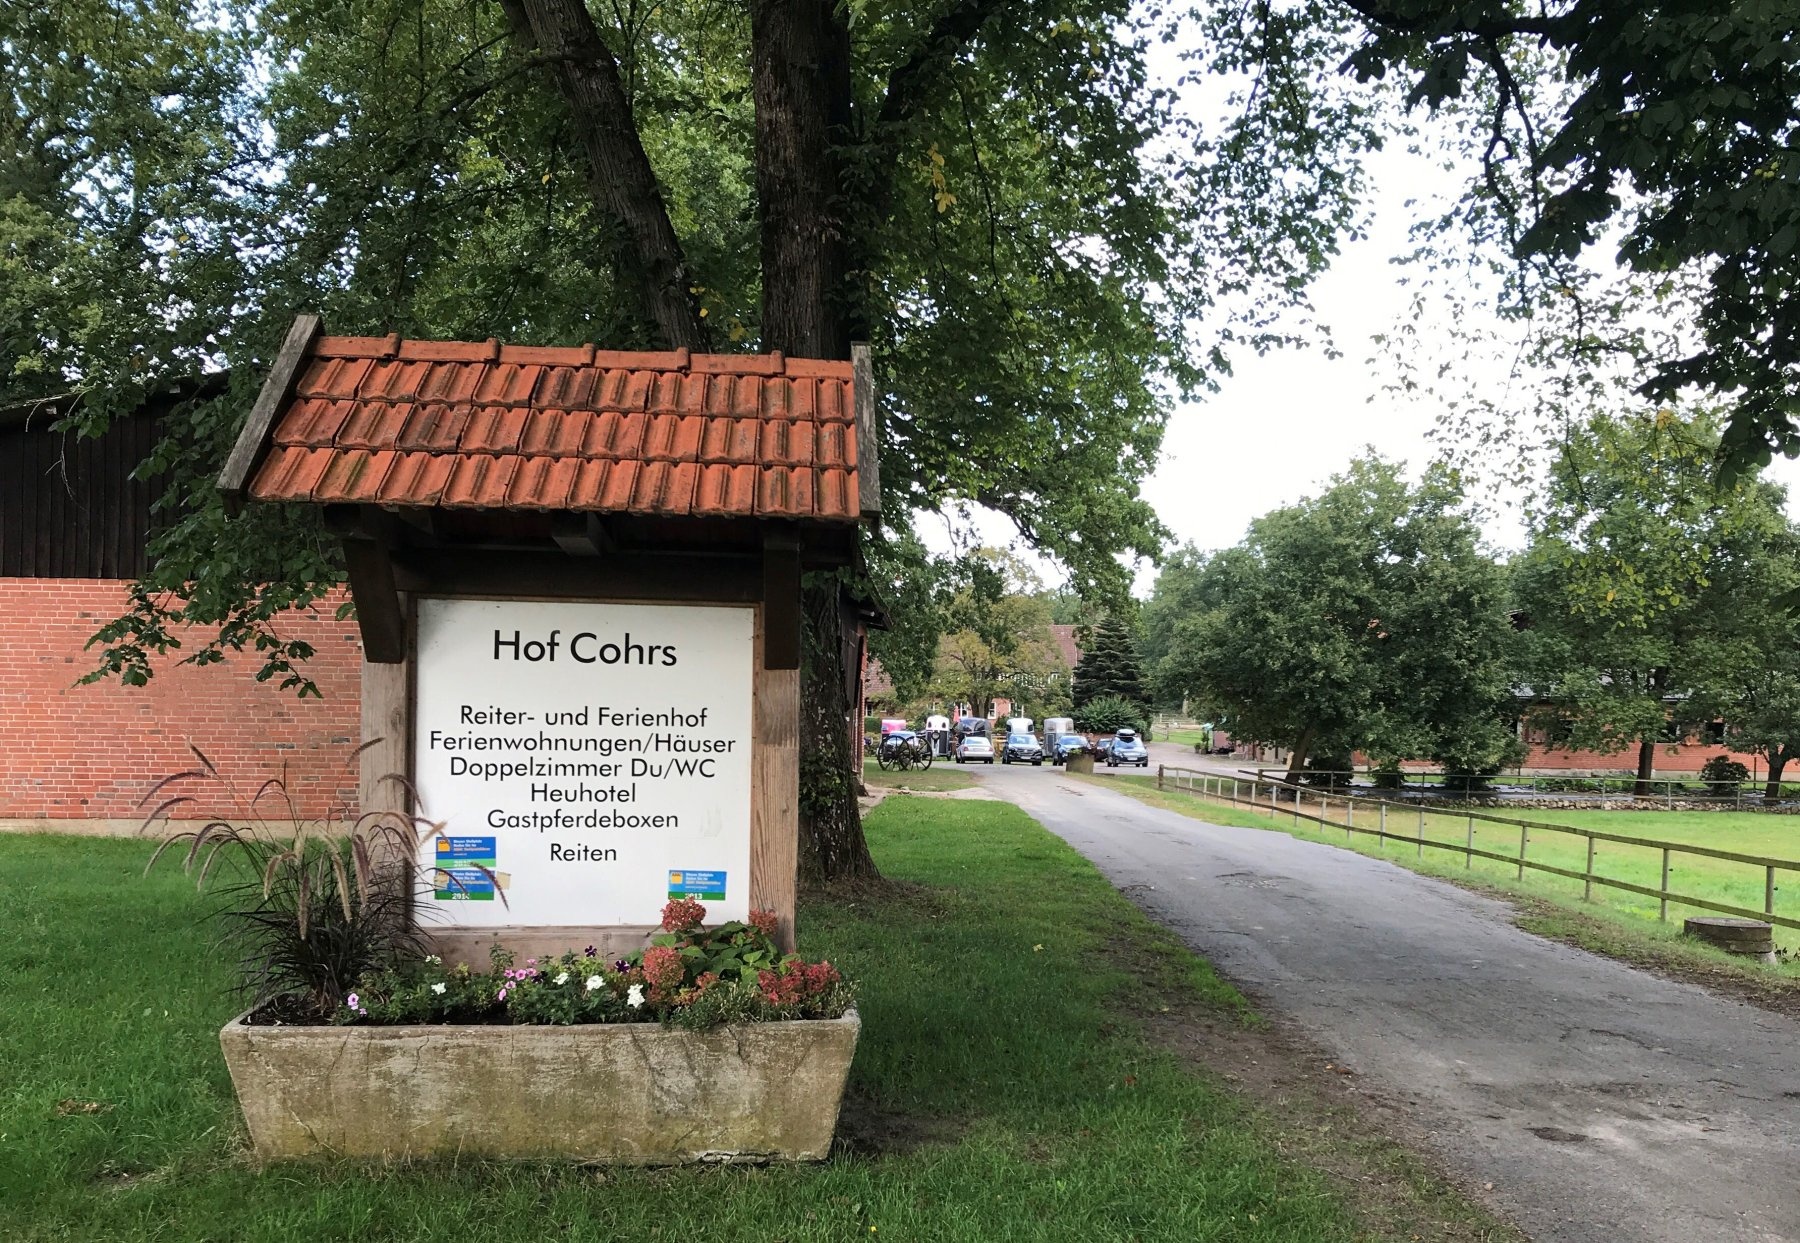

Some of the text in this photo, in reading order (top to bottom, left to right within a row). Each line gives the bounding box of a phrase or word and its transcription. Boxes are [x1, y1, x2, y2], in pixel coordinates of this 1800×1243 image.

[493, 629, 677, 667] Hof Cohrs
[460, 705, 708, 728] Reiter- und Ferienhof
[430, 731, 736, 757] Ferienwohnungen/Häuser
[450, 756, 716, 781] Doppelzimmer Du/WC
[531, 783, 636, 803] Heuhotel
[487, 809, 678, 833] Gastpferdeboxen
[550, 843, 617, 862] Reiten
